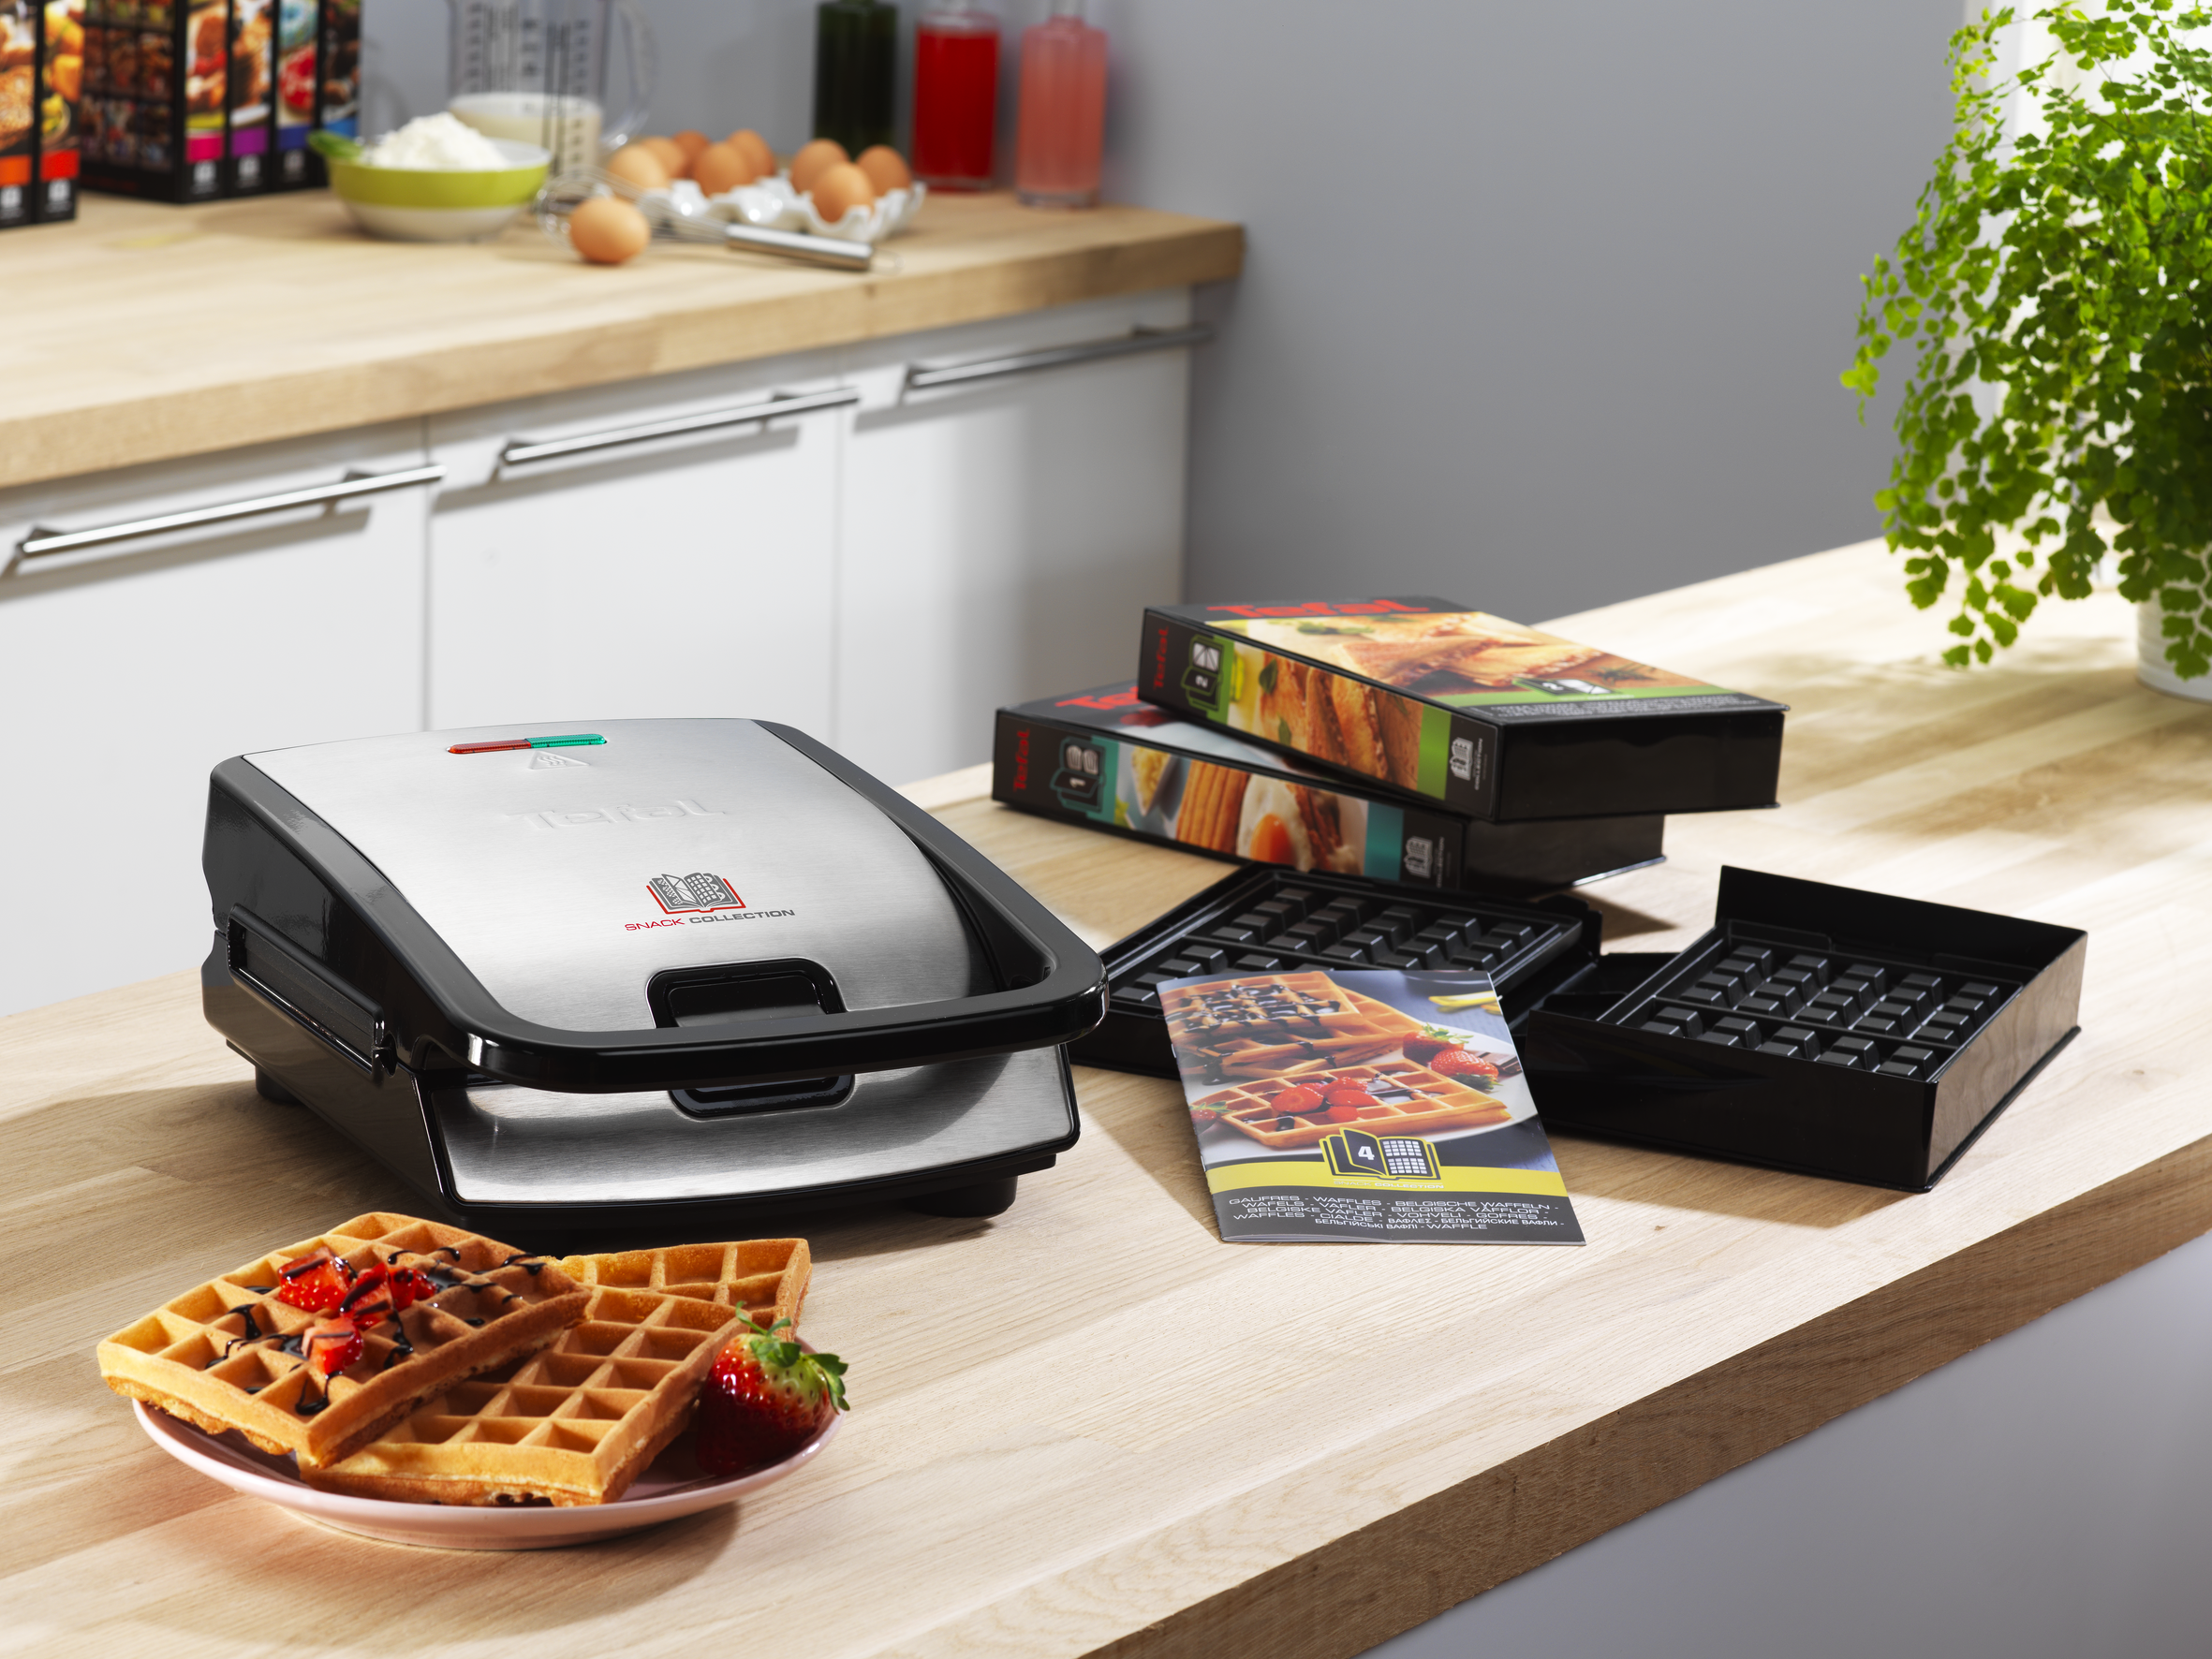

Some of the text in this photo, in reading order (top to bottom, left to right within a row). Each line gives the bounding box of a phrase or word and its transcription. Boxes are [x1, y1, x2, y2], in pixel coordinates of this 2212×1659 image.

[1205, 598, 1430, 618] Tefal
[1153, 626, 1170, 691] Tefal
[1195, 674, 1209, 689] 2
[1012, 727, 1031, 793] Tefal
[502, 799, 727, 830] Tefal
[625, 909, 796, 932] SNACK COLLECTION
[1358, 1145, 1375, 1161] 4
[1229, 1195, 1301, 1205] GAUFRES
[1313, 1196, 1382, 1206] WAFFLES
[1481, 1201, 1551, 1210] WAFFELN
[1319, 1202, 1377, 1211] VAFLER
[1320, 1213, 1374, 1222] CIALDE
[1325, 1208, 1383, 1217] VAFLER
